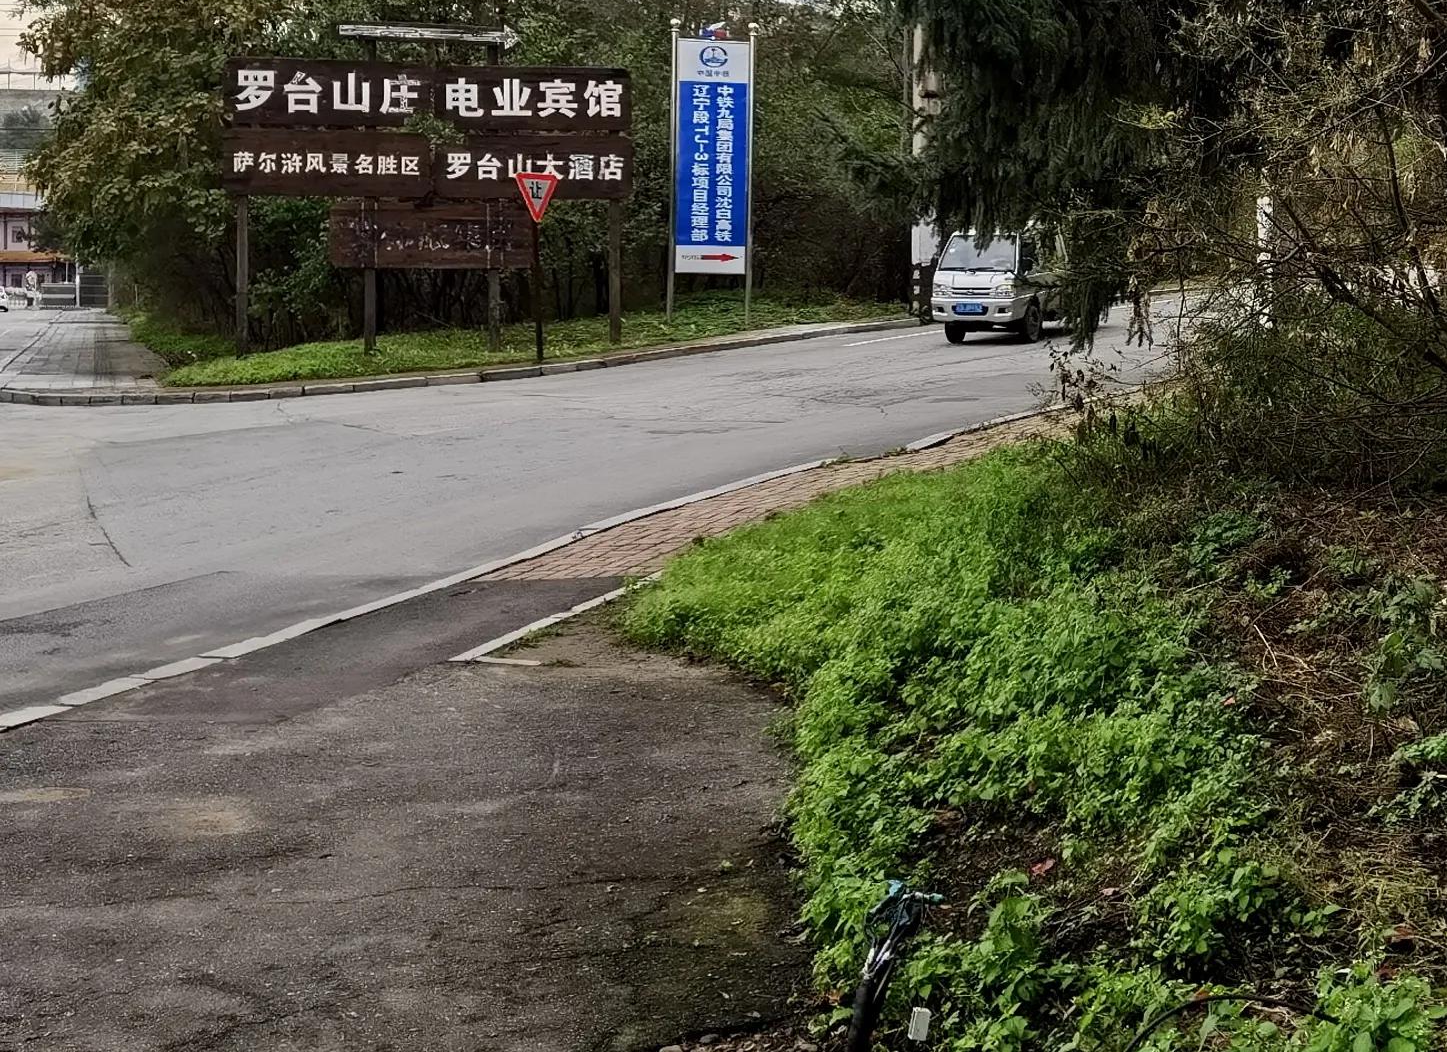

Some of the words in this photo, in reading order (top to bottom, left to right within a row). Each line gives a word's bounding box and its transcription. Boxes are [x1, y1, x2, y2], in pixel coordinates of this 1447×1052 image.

[234, 69, 421, 114] 罗台山庄
[445, 76, 624, 119] 电业宾馆
[232, 151, 421, 176] 萨尔浒风景名胜区
[445, 151, 625, 181] 罗台山大酒店
[529, 181, 542, 200] 让
